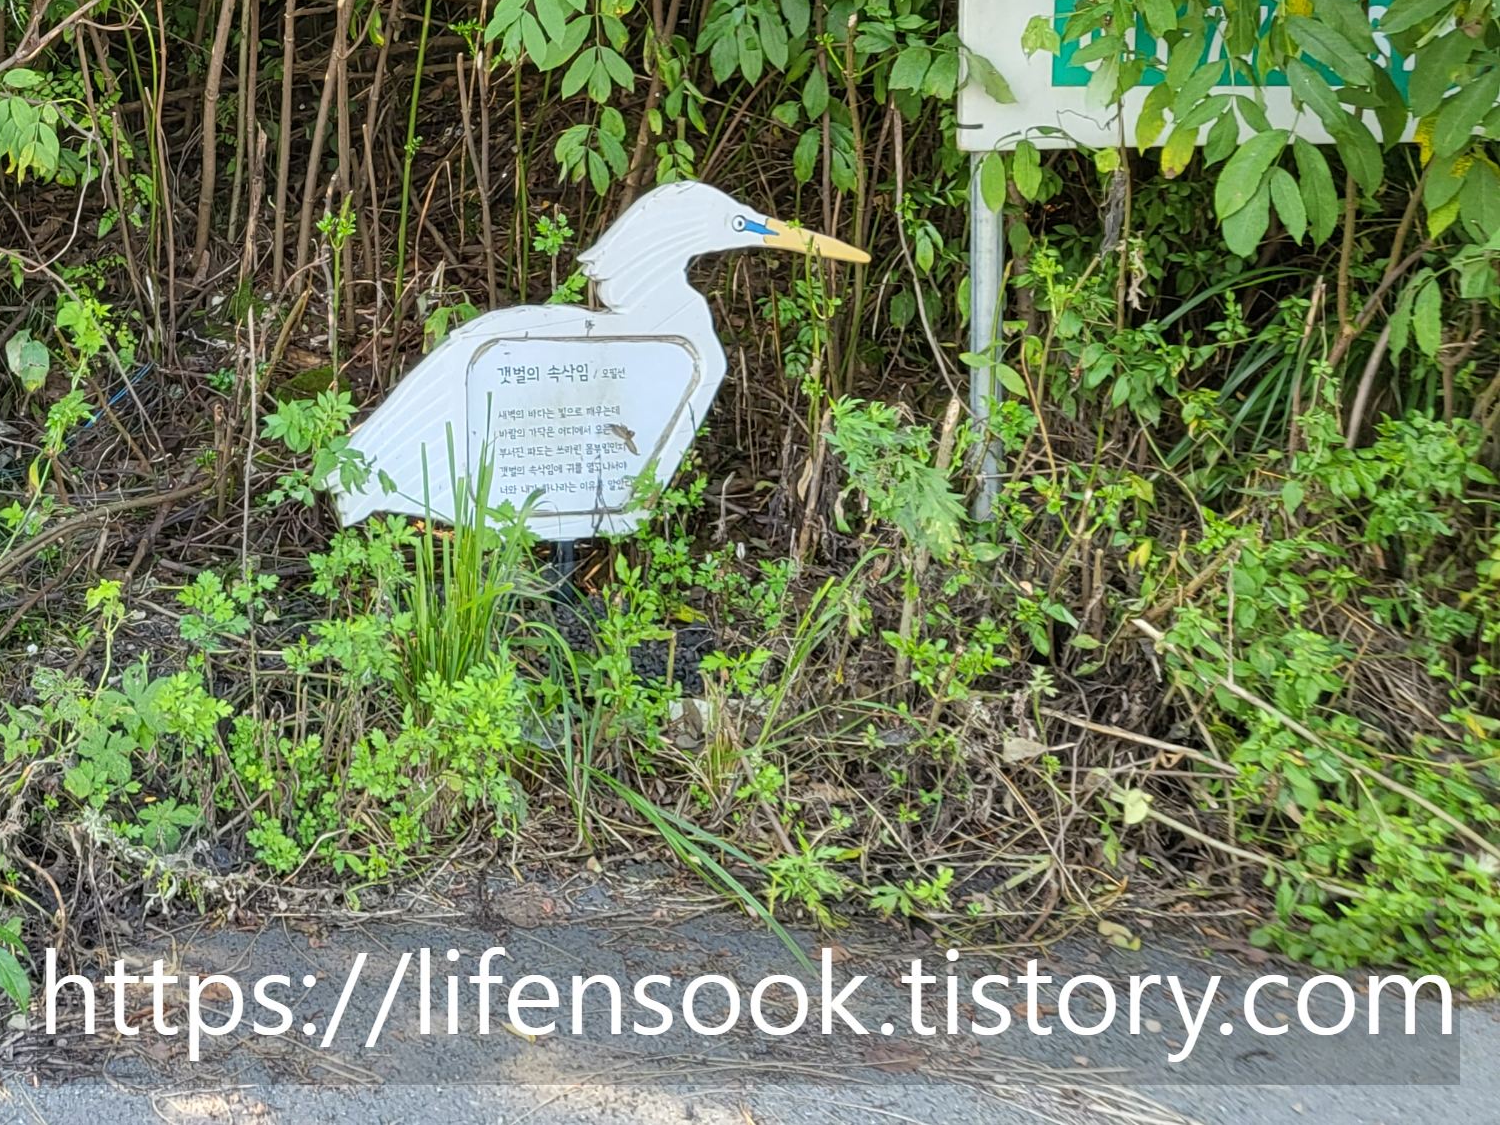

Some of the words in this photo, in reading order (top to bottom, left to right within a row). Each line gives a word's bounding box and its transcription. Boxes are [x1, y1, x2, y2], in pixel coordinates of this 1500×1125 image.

[497, 365, 540, 384] 갯벌의
[547, 363, 589, 383] 속삭임
[498, 408, 525, 421] 새벽의
[528, 407, 555, 419] 바다는
[558, 406, 583, 419] 빛으로
[499, 425, 525, 440] 바람의
[529, 426, 555, 438] 가닥은
[558, 425, 591, 436] 어디에서
[499, 446, 524, 458] 부서진
[527, 445, 553, 457] 파도는
[556, 443, 583, 456] 쓰라린
[499, 464, 525, 477] 갯벌의
[528, 463, 563, 475] 속삭임에
[566, 462, 583, 474] 귀를
[500, 484, 517, 495] 너와
